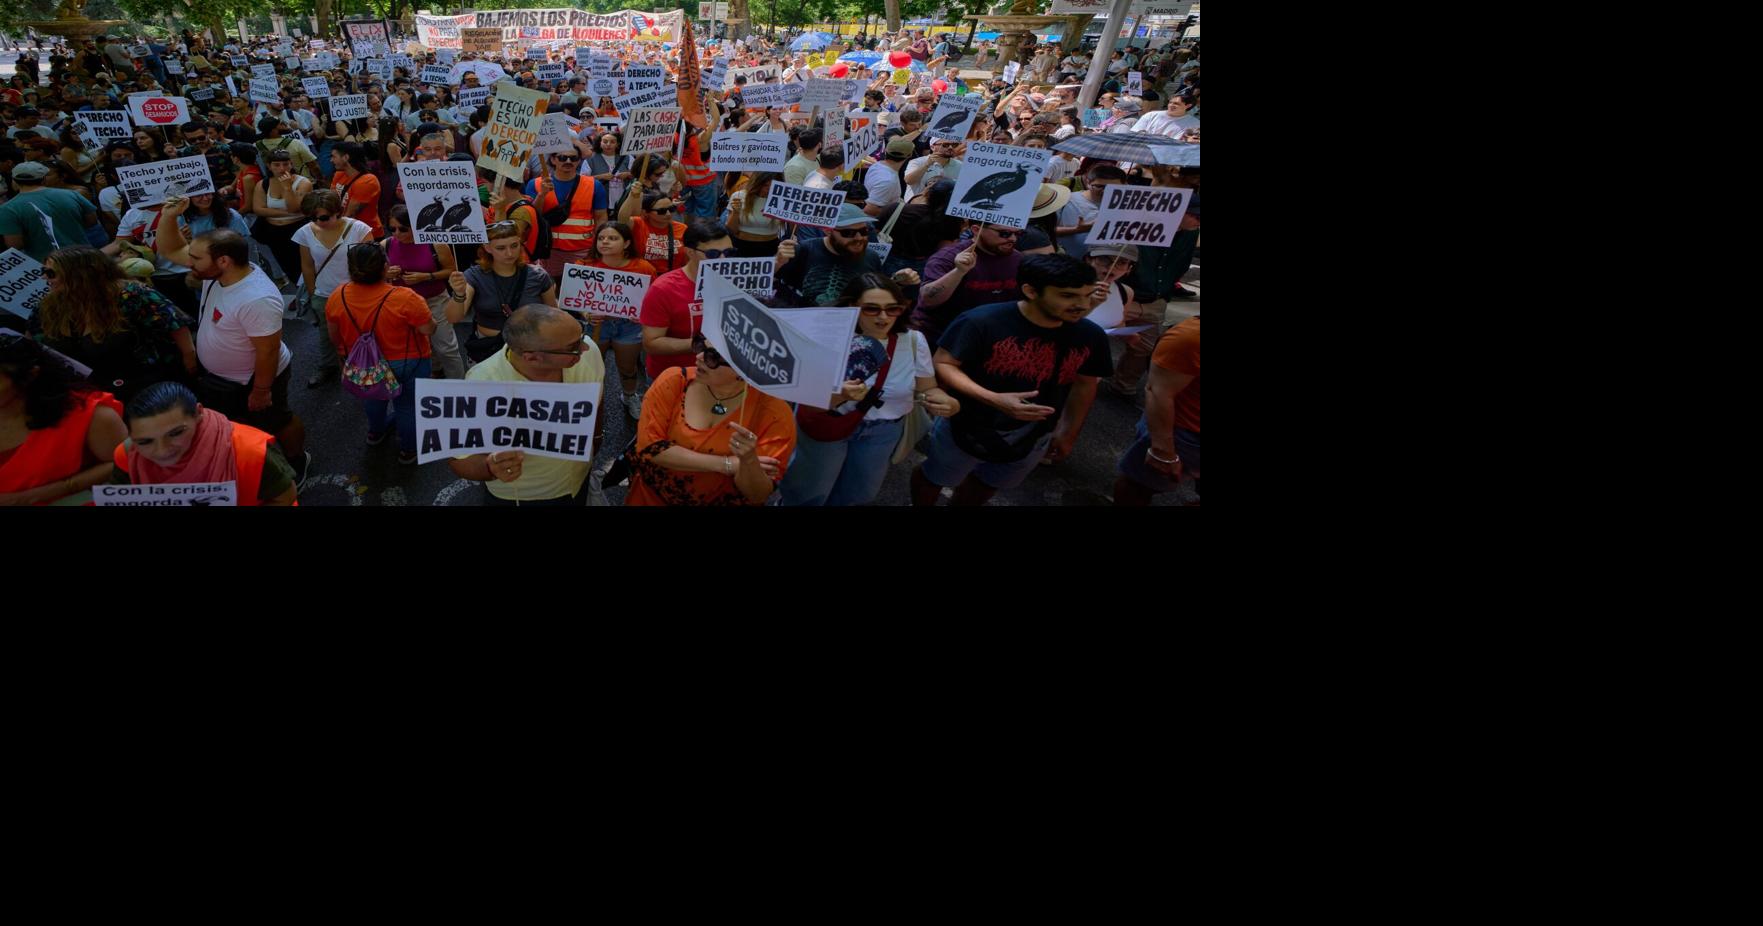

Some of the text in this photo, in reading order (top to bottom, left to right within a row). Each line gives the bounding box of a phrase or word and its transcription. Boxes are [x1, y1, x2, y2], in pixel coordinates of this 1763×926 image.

[476, 10, 628, 28] BAJEMOS LOS PRECIOS
[505, 28, 517, 40] LA
[557, 28, 570, 40] DE
[572, 28, 627, 40] ALQUILERES
[627, 69, 660, 77] DERECHO
[629, 82, 634, 90] A
[498, 98, 534, 117] TECHO
[616, 99, 630, 110] SIN
[630, 92, 657, 105] CASA?
[941, 102, 964, 110] engorda
[344, 107, 366, 116] JUSTO!
[496, 111, 530, 129] ES UN
[634, 111, 679, 123] LAS CASAS
[93, 127, 128, 137] TECHO.
[491, 122, 537, 145] DERECHO
[633, 125, 655, 138] PARA
[627, 140, 645, 152] LAS
[713, 141, 781, 153] Buitres y gaviotas,
[972, 143, 1045, 161] Con la crisis,
[749, 155, 778, 165] explotan.
[968, 156, 1013, 169] engorda
[120, 168, 156, 180] ¡Techo
[166, 160, 204, 171] trabajo,
[124, 168, 206, 189] sin ser esclavo!
[404, 166, 471, 179] Con la crisis,
[407, 180, 476, 192] engordamos.
[772, 184, 843, 206] DERECHO
[1108, 190, 1183, 213] DERECHO
[768, 196, 839, 219] A TECHO
[774, 209, 800, 221] JUSTO
[801, 216, 835, 226] PRECIO!
[951, 207, 1022, 228] BANCO BUITRE.
[419, 233, 485, 243] BANCO BUITRE.
[1096, 221, 1166, 243] A TECHO.
[568, 268, 643, 288] CASAS PARA
[584, 280, 623, 295] VIVIR
[578, 290, 630, 304] NO PARA
[564, 298, 637, 317] ESPECULAR
[727, 304, 787, 359] STOP
[723, 321, 788, 384] DESAHUCIOS
[421, 396, 593, 424] SIN CASA?
[421, 427, 588, 455] A LA CALLE!
[102, 486, 142, 496] Con
[150, 486, 164, 494] la
